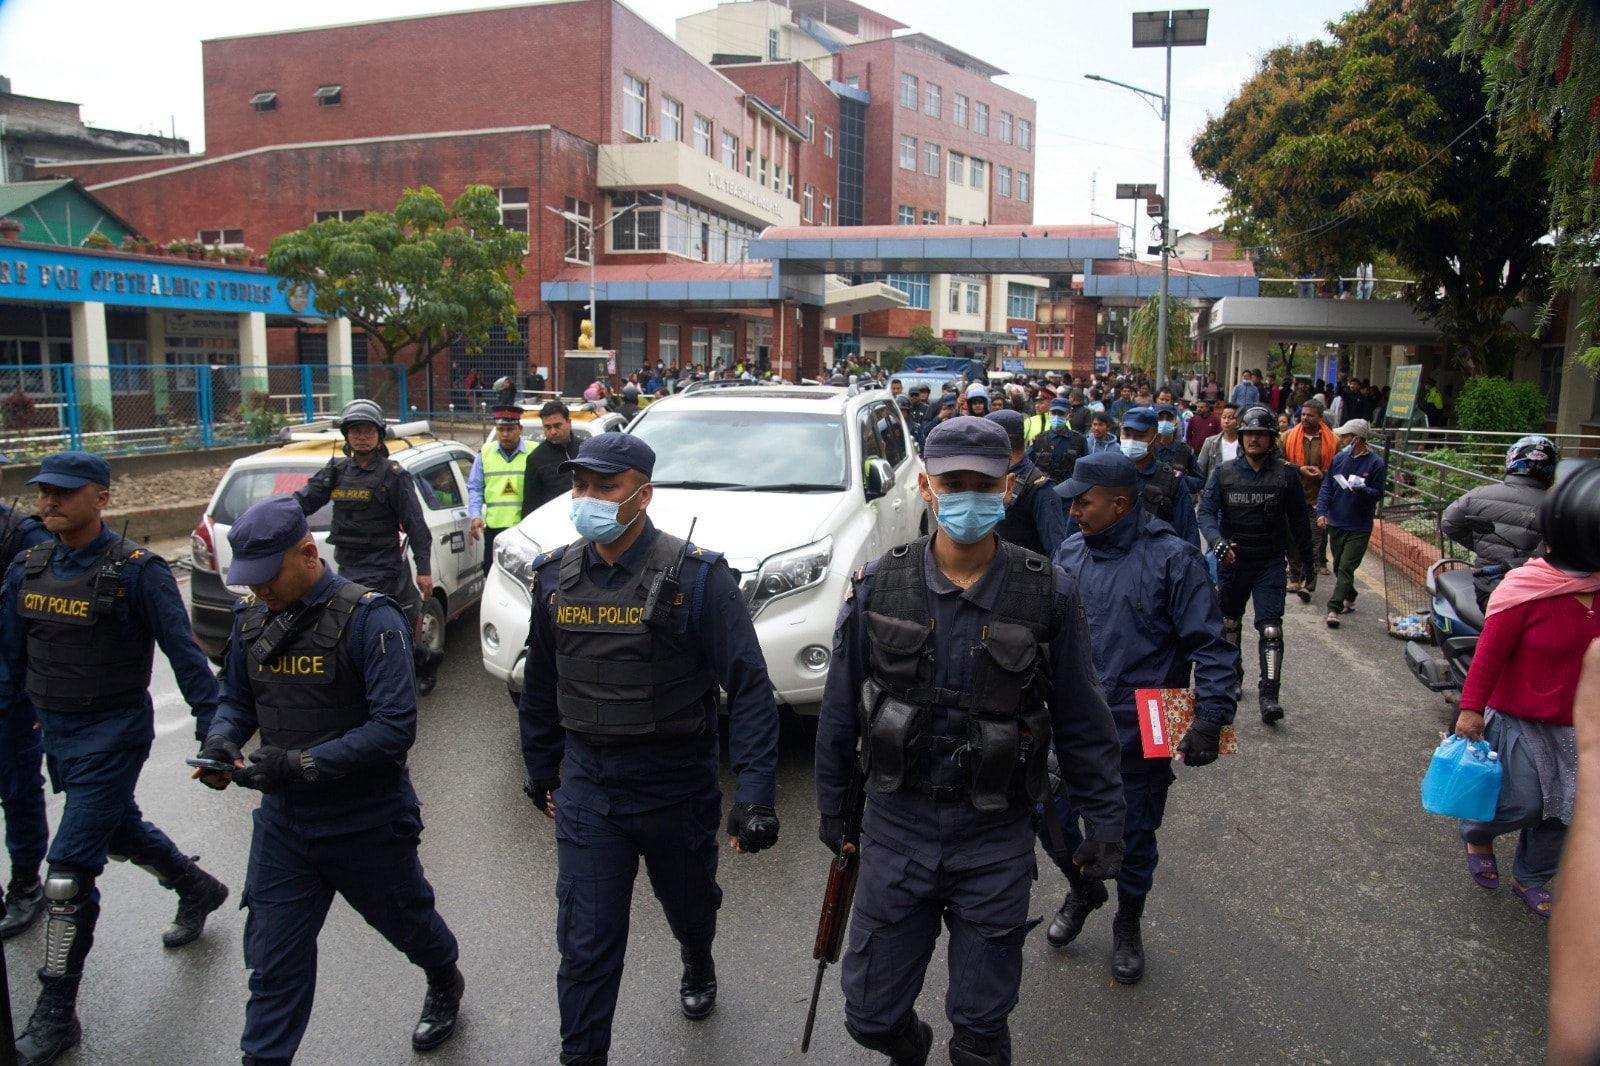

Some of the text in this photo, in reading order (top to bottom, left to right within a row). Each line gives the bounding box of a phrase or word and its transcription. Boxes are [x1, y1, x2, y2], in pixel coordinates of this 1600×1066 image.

[39, 264, 80, 290] FOR
[91, 269, 202, 299] OPHTHALMIC
[206, 280, 272, 303] STUDIES
[1228, 492, 1250, 504] NEPAL
[25, 593, 89, 617] CITY POLICE
[557, 606, 594, 625] NEPAL
